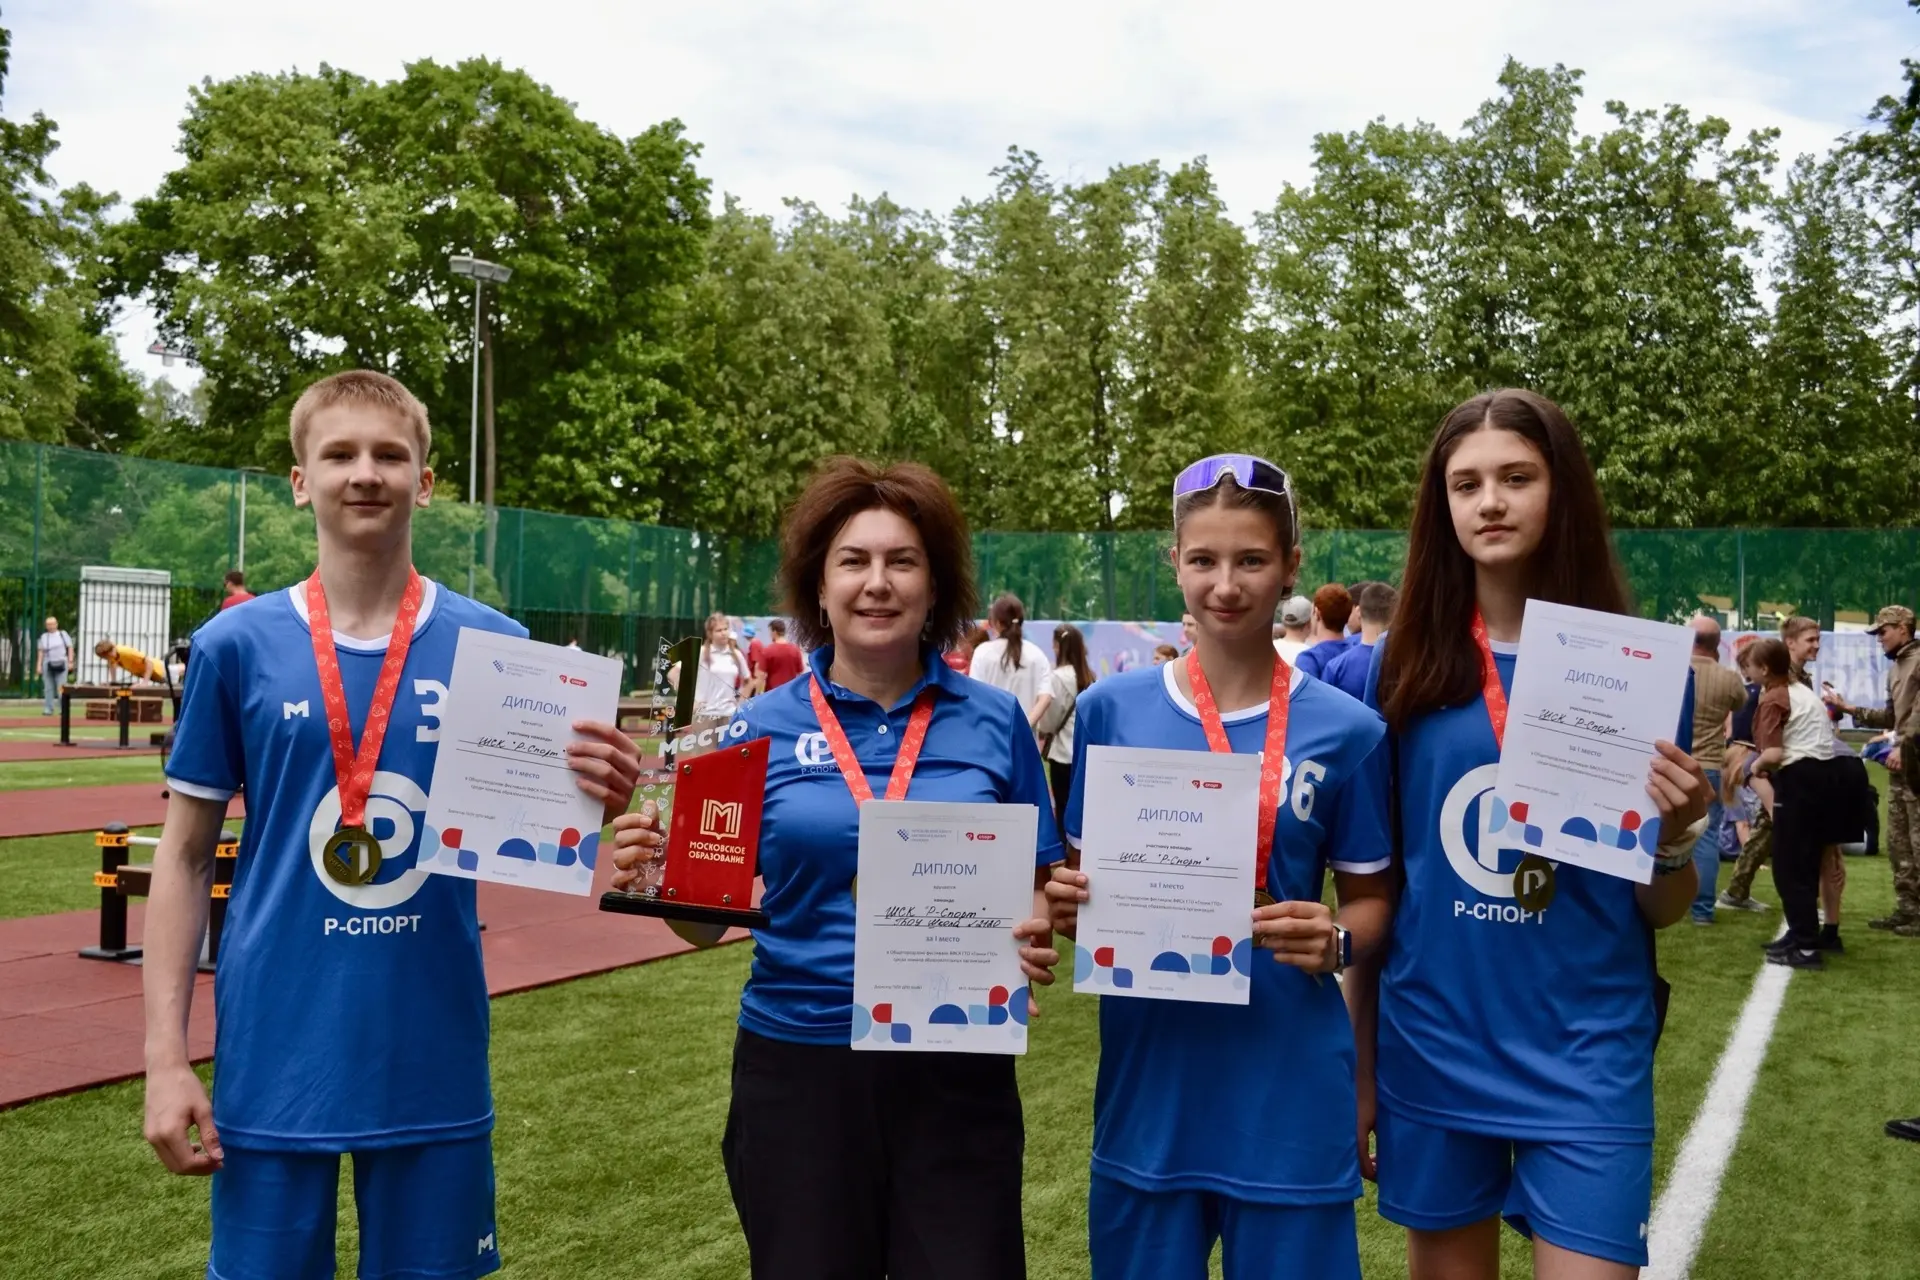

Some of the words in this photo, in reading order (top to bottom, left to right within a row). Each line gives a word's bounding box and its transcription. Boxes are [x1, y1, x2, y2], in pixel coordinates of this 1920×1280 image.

[1564, 668, 1628, 692] ДИПЛОМ
[502, 695, 567, 717] ДИПЛОМ
[1581, 747, 1602, 758] место
[519, 771, 540, 780] место
[1137, 807, 1203, 823] ДИПЛОМ
[689, 840, 746, 855] МОСКОВСКОЕ
[688, 850, 745, 864] ОБРАЗОВАНИЕ
[911, 862, 977, 877] ДИПЛОМ
[885, 906, 916, 919] ШСК
[324, 914, 422, 936] Р-СПОРТ
